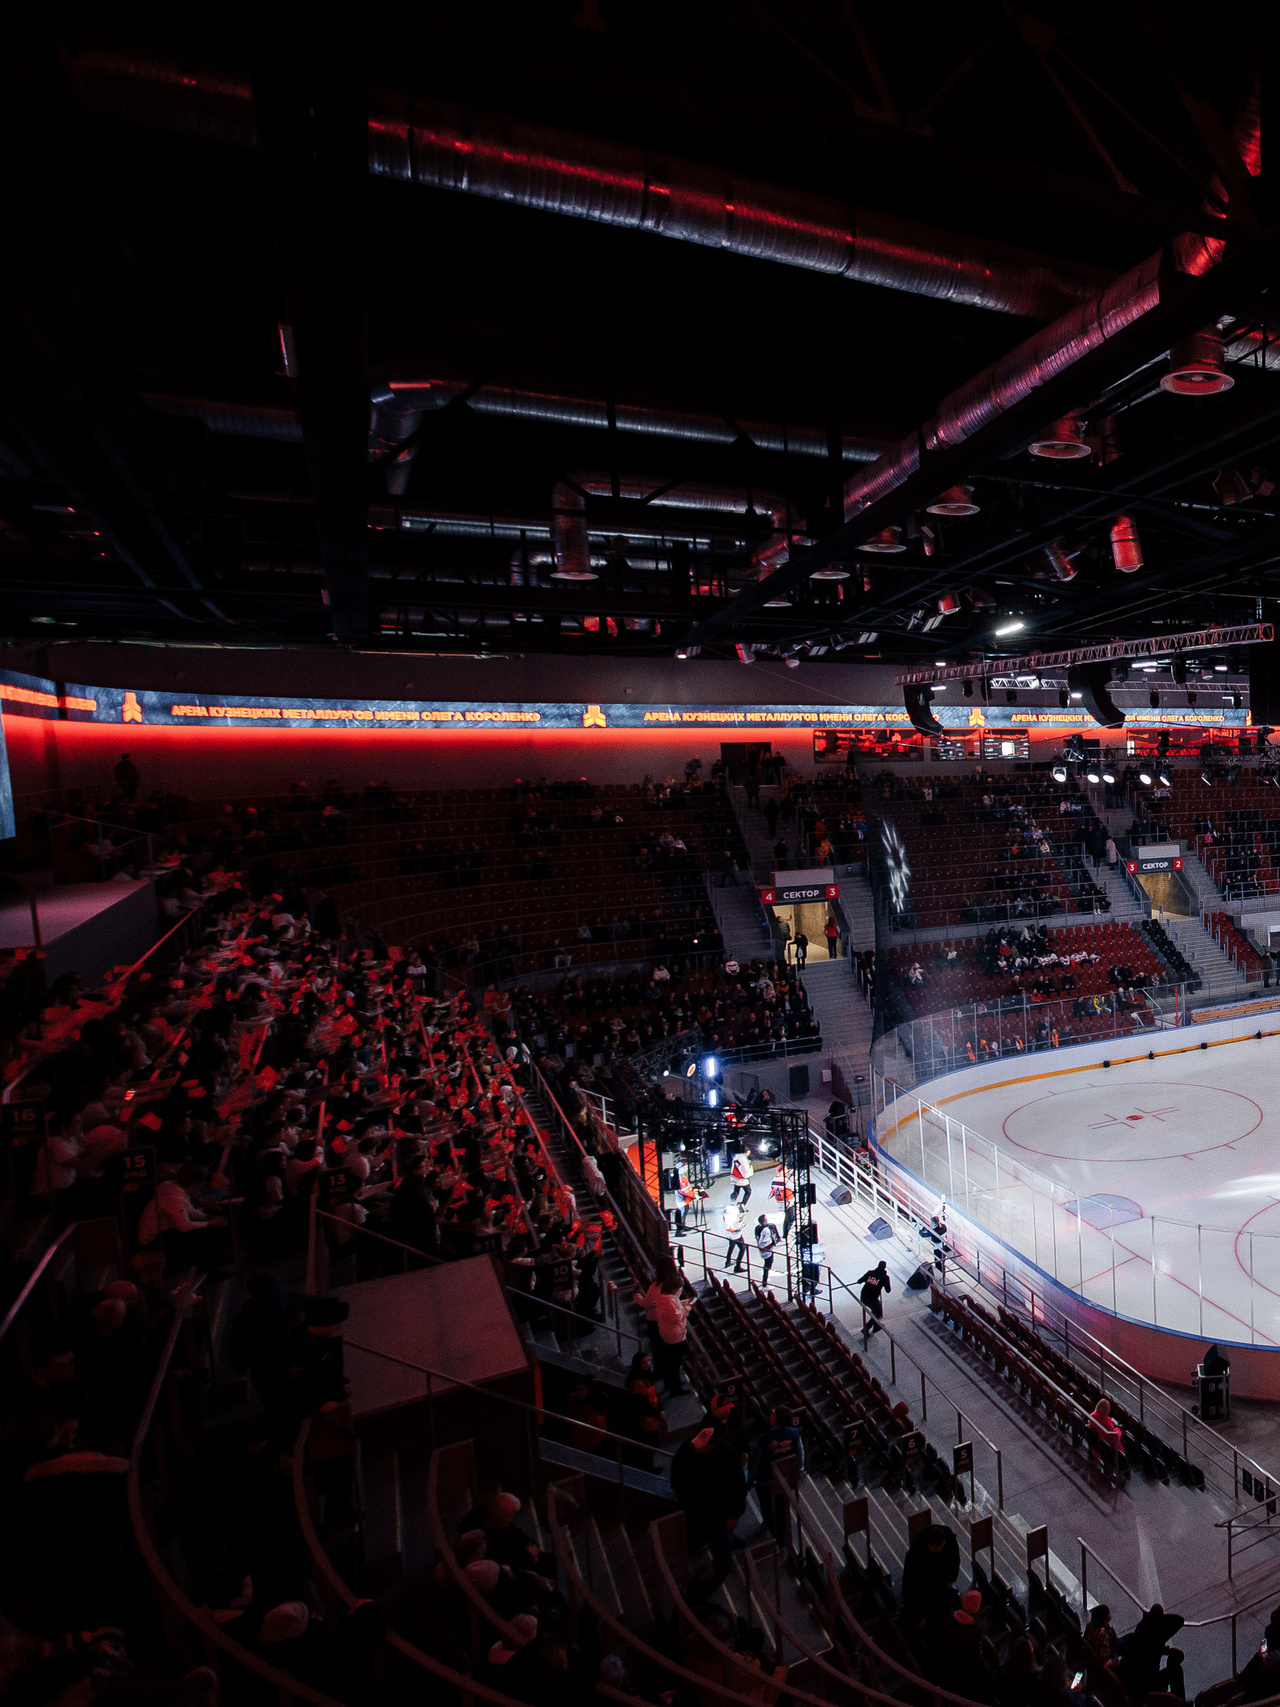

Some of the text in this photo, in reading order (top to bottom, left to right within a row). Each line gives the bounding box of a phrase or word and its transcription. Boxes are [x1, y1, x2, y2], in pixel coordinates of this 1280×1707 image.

[171, 704, 541, 722] АРЕНА КУЗНЕЦКИХ МЕТАЛЛУРГОВ ИМЕНИ ОЛЕГА КОРОЛЕНКО
[643, 712, 940, 723] АРЕНА КУЗНЕЦКИХ МЕТАЛЛУРГОВ ИМЕНИ ОЛЕГА КОРОО
[1011, 714, 1037, 722] АРЕНА
[1038, 714, 1083, 723] КУЗНЕЦКИХ
[1162, 714, 1184, 722] ОЛЕГА
[1185, 714, 1225, 722] КОРОЛЕНКО
[1142, 861, 1169, 870] СЕКТОР
[765, 888, 836, 901] 4 СЕКТОР 3
[10, 1107, 37, 1123] 16
[123, 1154, 146, 1169] 15
[328, 1174, 347, 1186] 13
[553, 1265, 569, 1277] 10
[727, 1385, 736, 1395] 9
[850, 1429, 859, 1440] 7
[907, 1438, 916, 1448] 6
[960, 1449, 968, 1459] 5
